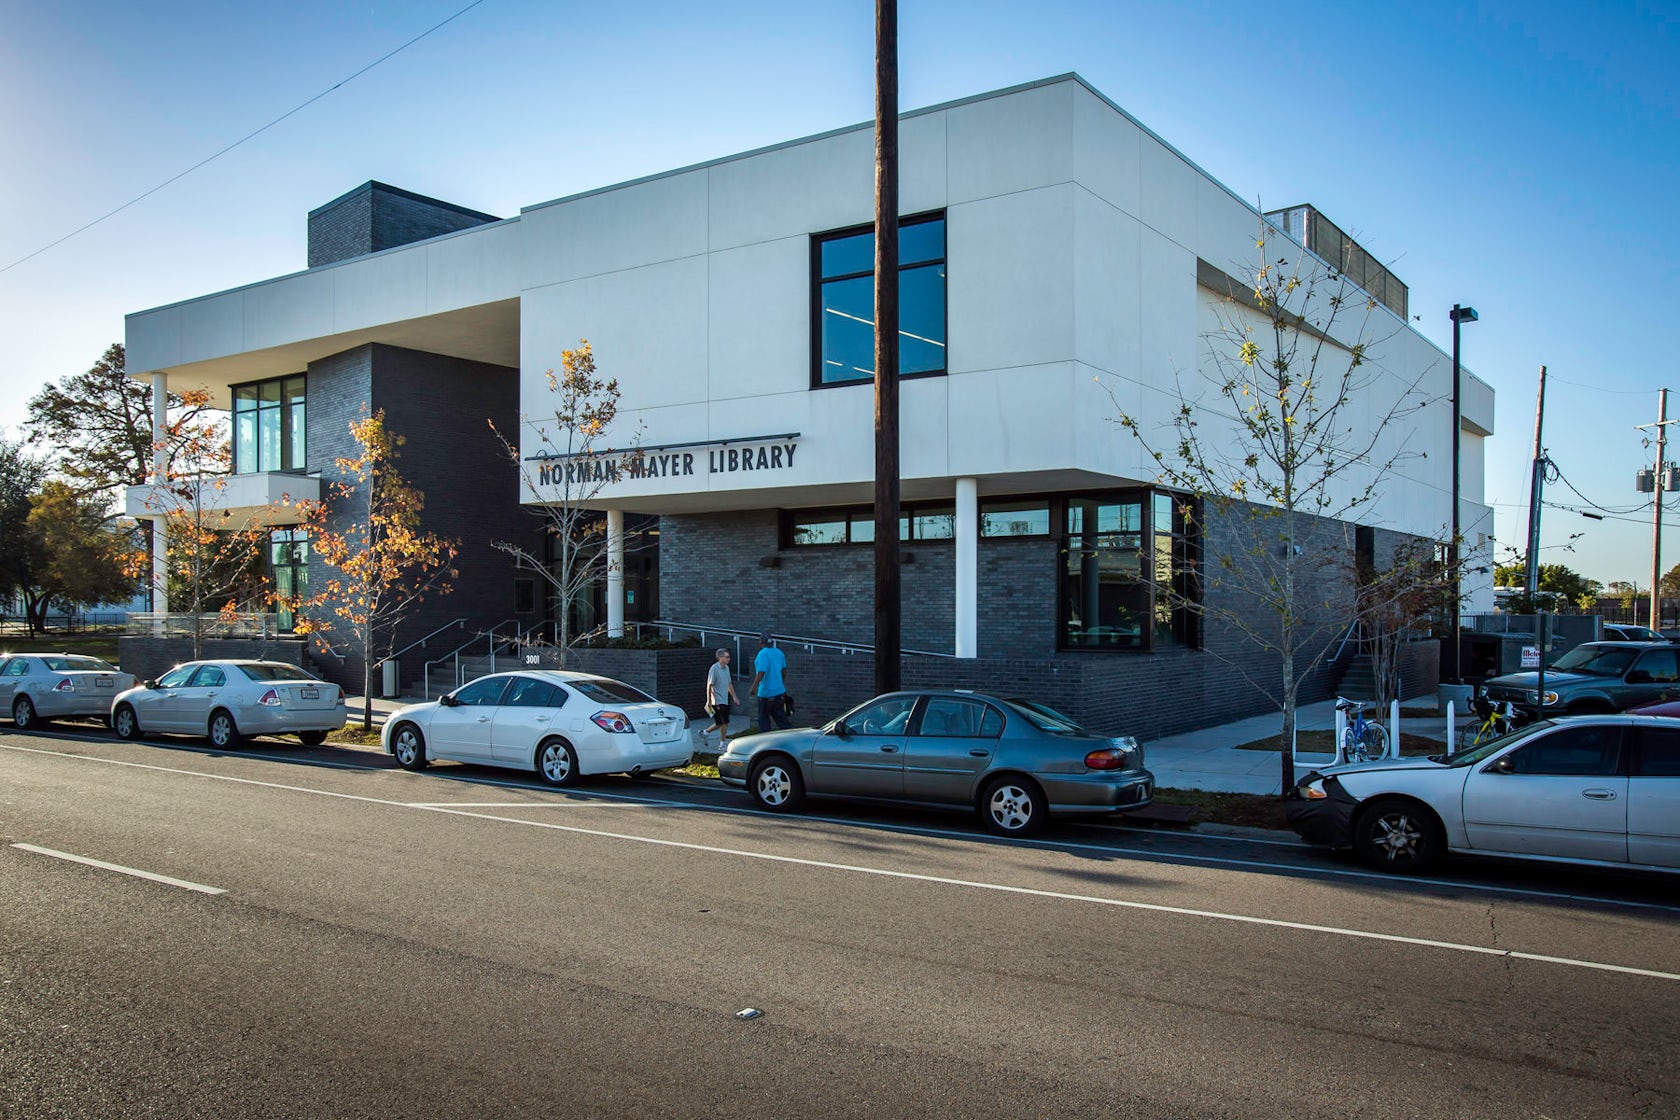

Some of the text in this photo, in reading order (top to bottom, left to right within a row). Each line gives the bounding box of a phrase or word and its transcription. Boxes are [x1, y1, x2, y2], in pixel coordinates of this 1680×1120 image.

[539, 444, 797, 486] NORMAN MAYER LIBRARY
[525, 654, 540, 665] 3001
